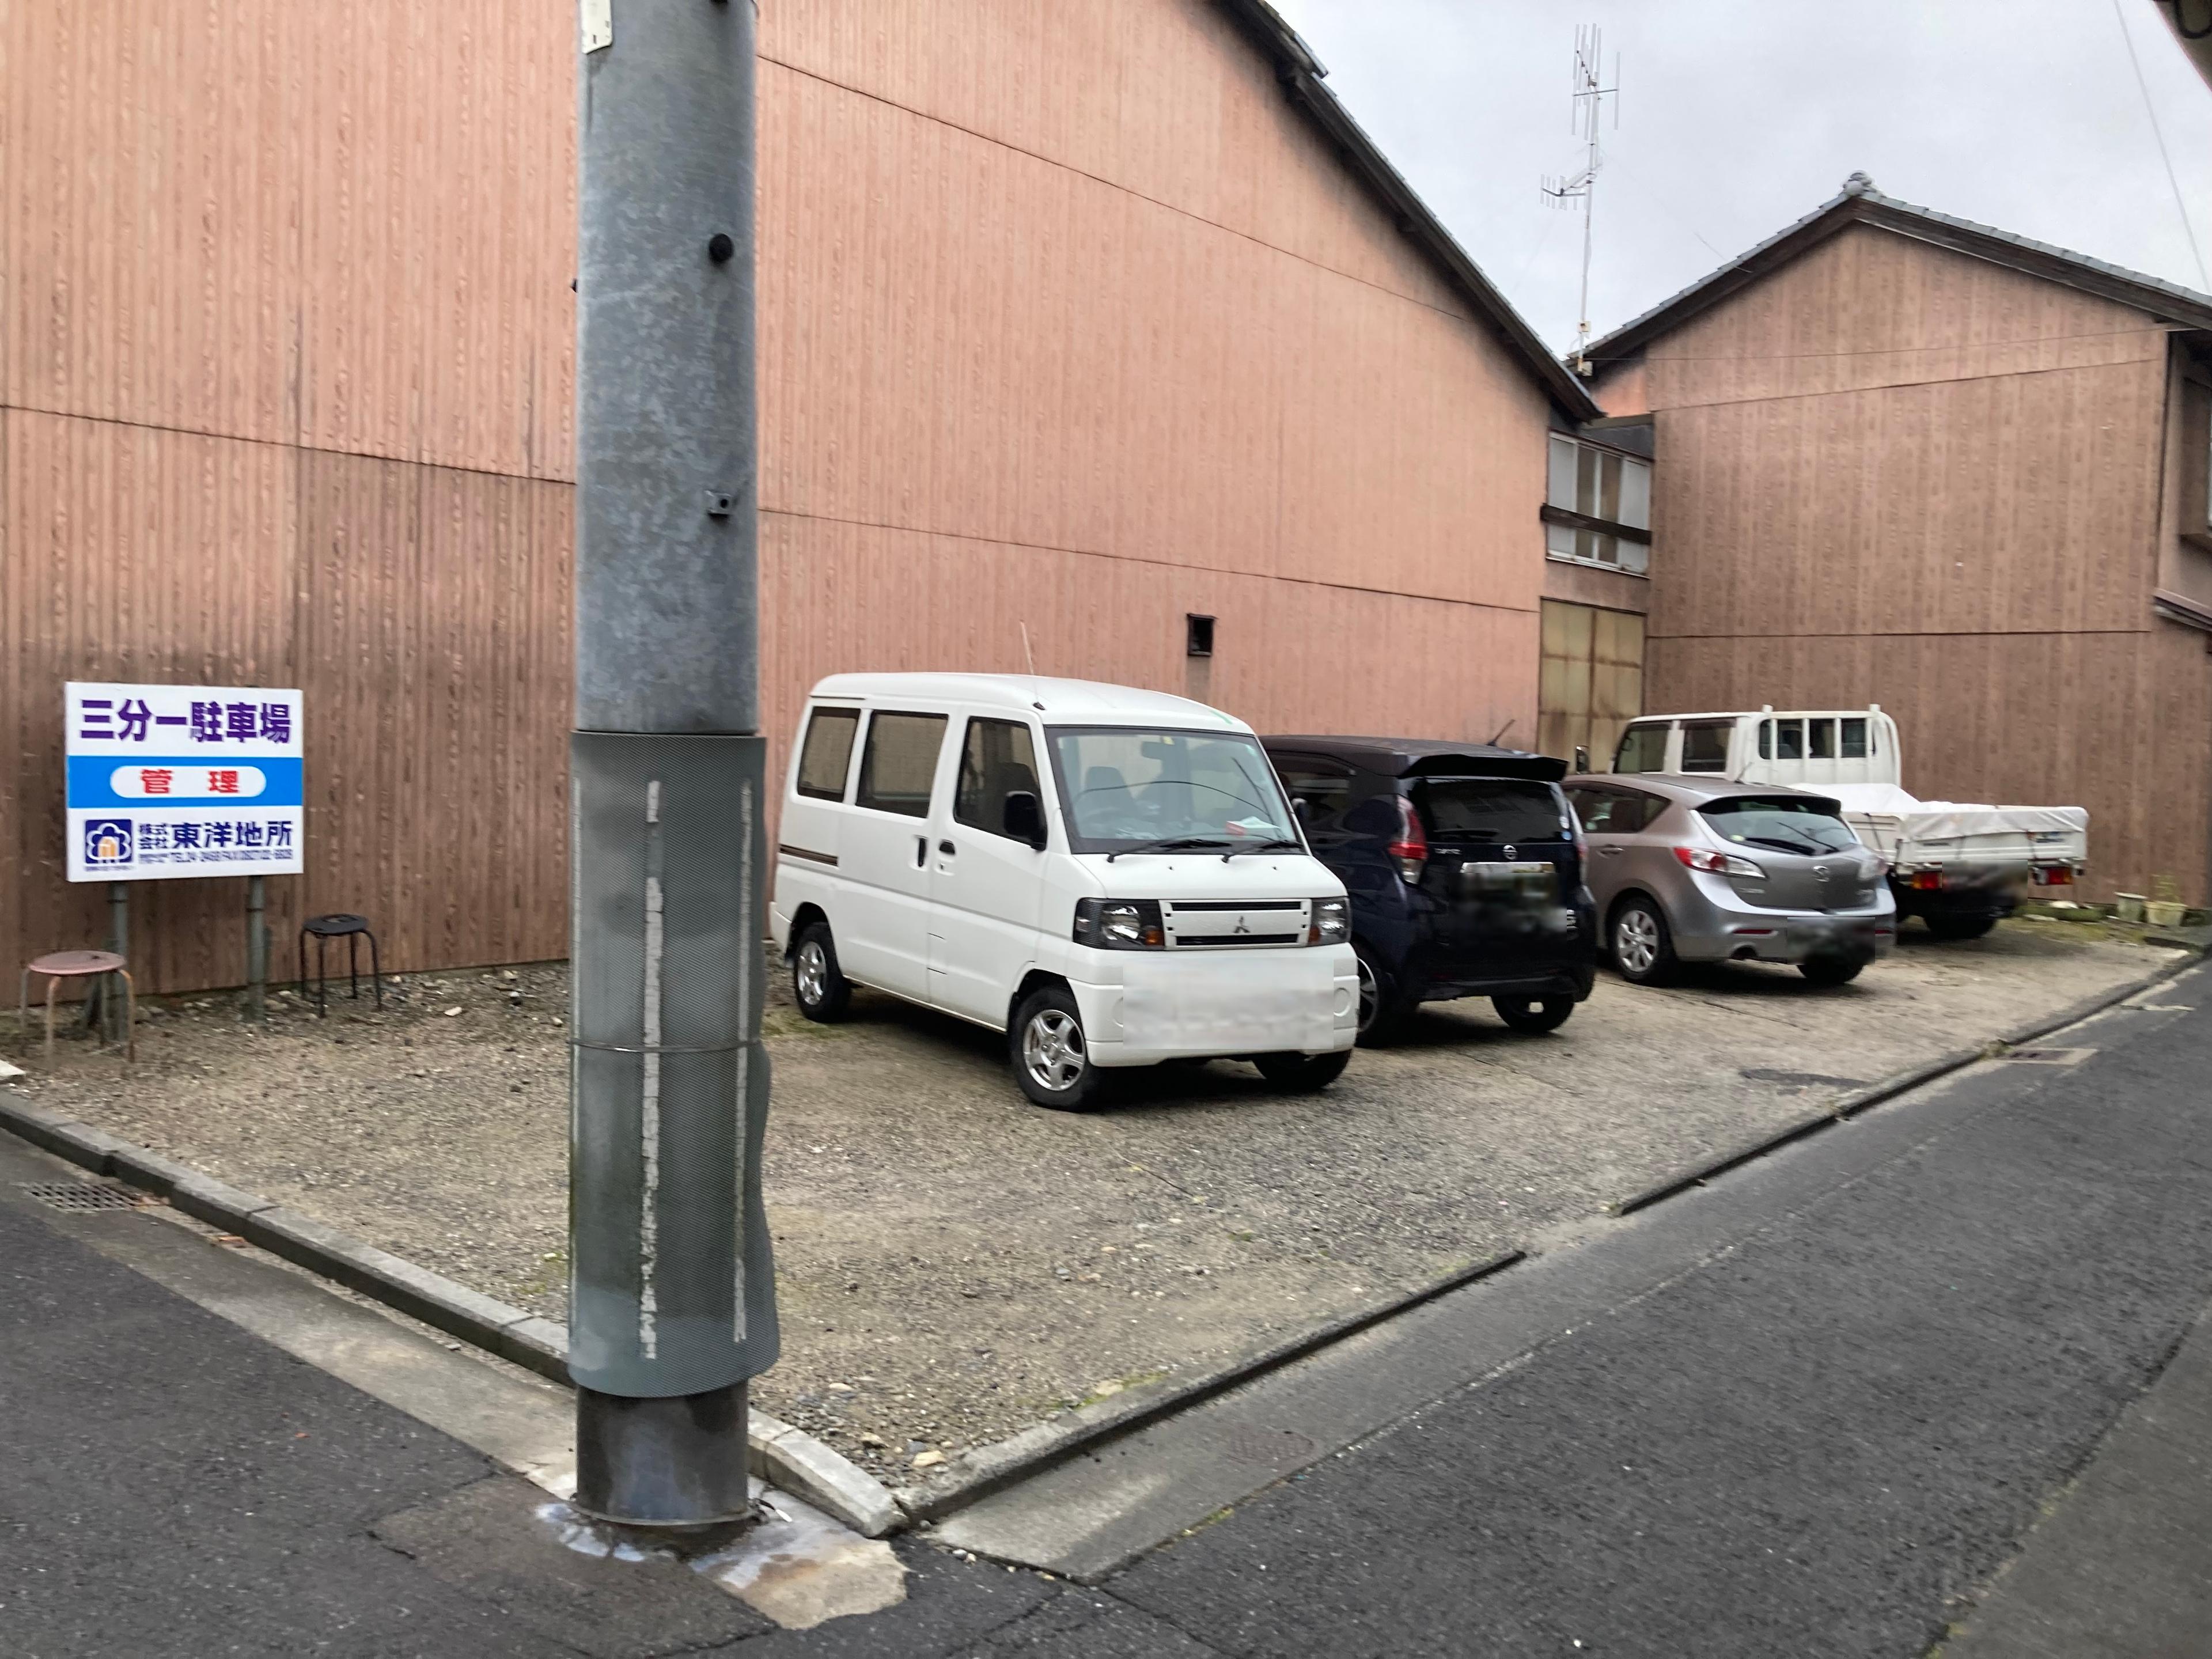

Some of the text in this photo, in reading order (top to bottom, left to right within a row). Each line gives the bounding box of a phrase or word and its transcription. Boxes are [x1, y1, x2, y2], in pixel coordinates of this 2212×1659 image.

[81, 699, 291, 743] 三分一駐車場
[171, 820, 293, 849] 東洋地所
